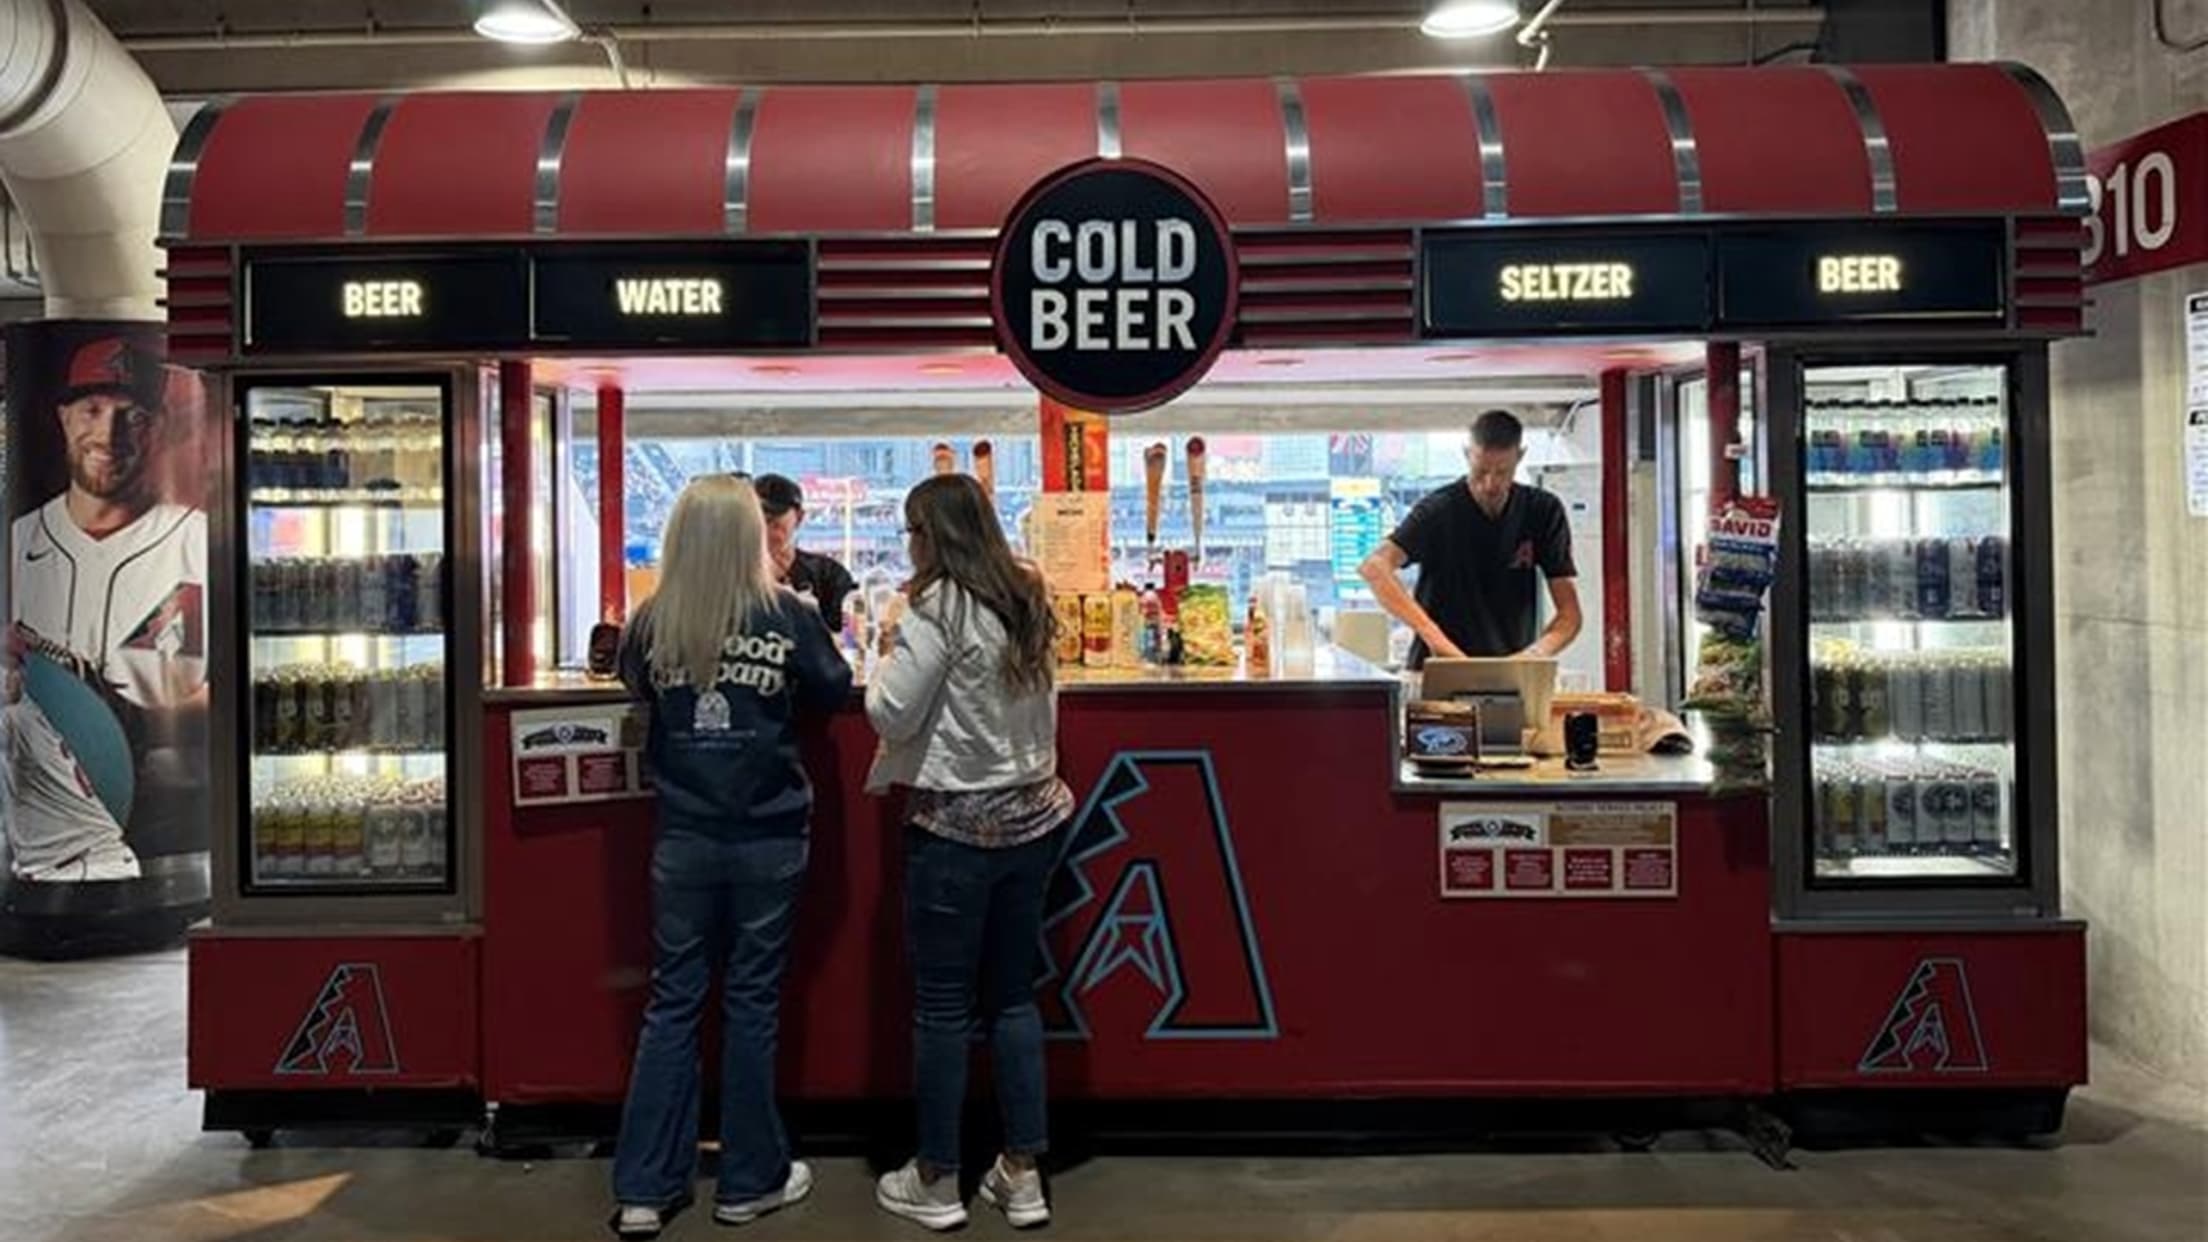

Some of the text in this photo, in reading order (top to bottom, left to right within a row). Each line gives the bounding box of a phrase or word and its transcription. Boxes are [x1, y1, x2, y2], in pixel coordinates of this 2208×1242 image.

[1031, 218, 1197, 284] COLD
[1500, 263, 1633, 301] SELTZER
[1819, 256, 1900, 293] BEER
[344, 281, 422, 316] BEER
[617, 280, 722, 314] WATER
[1031, 289, 1197, 351] BEER
